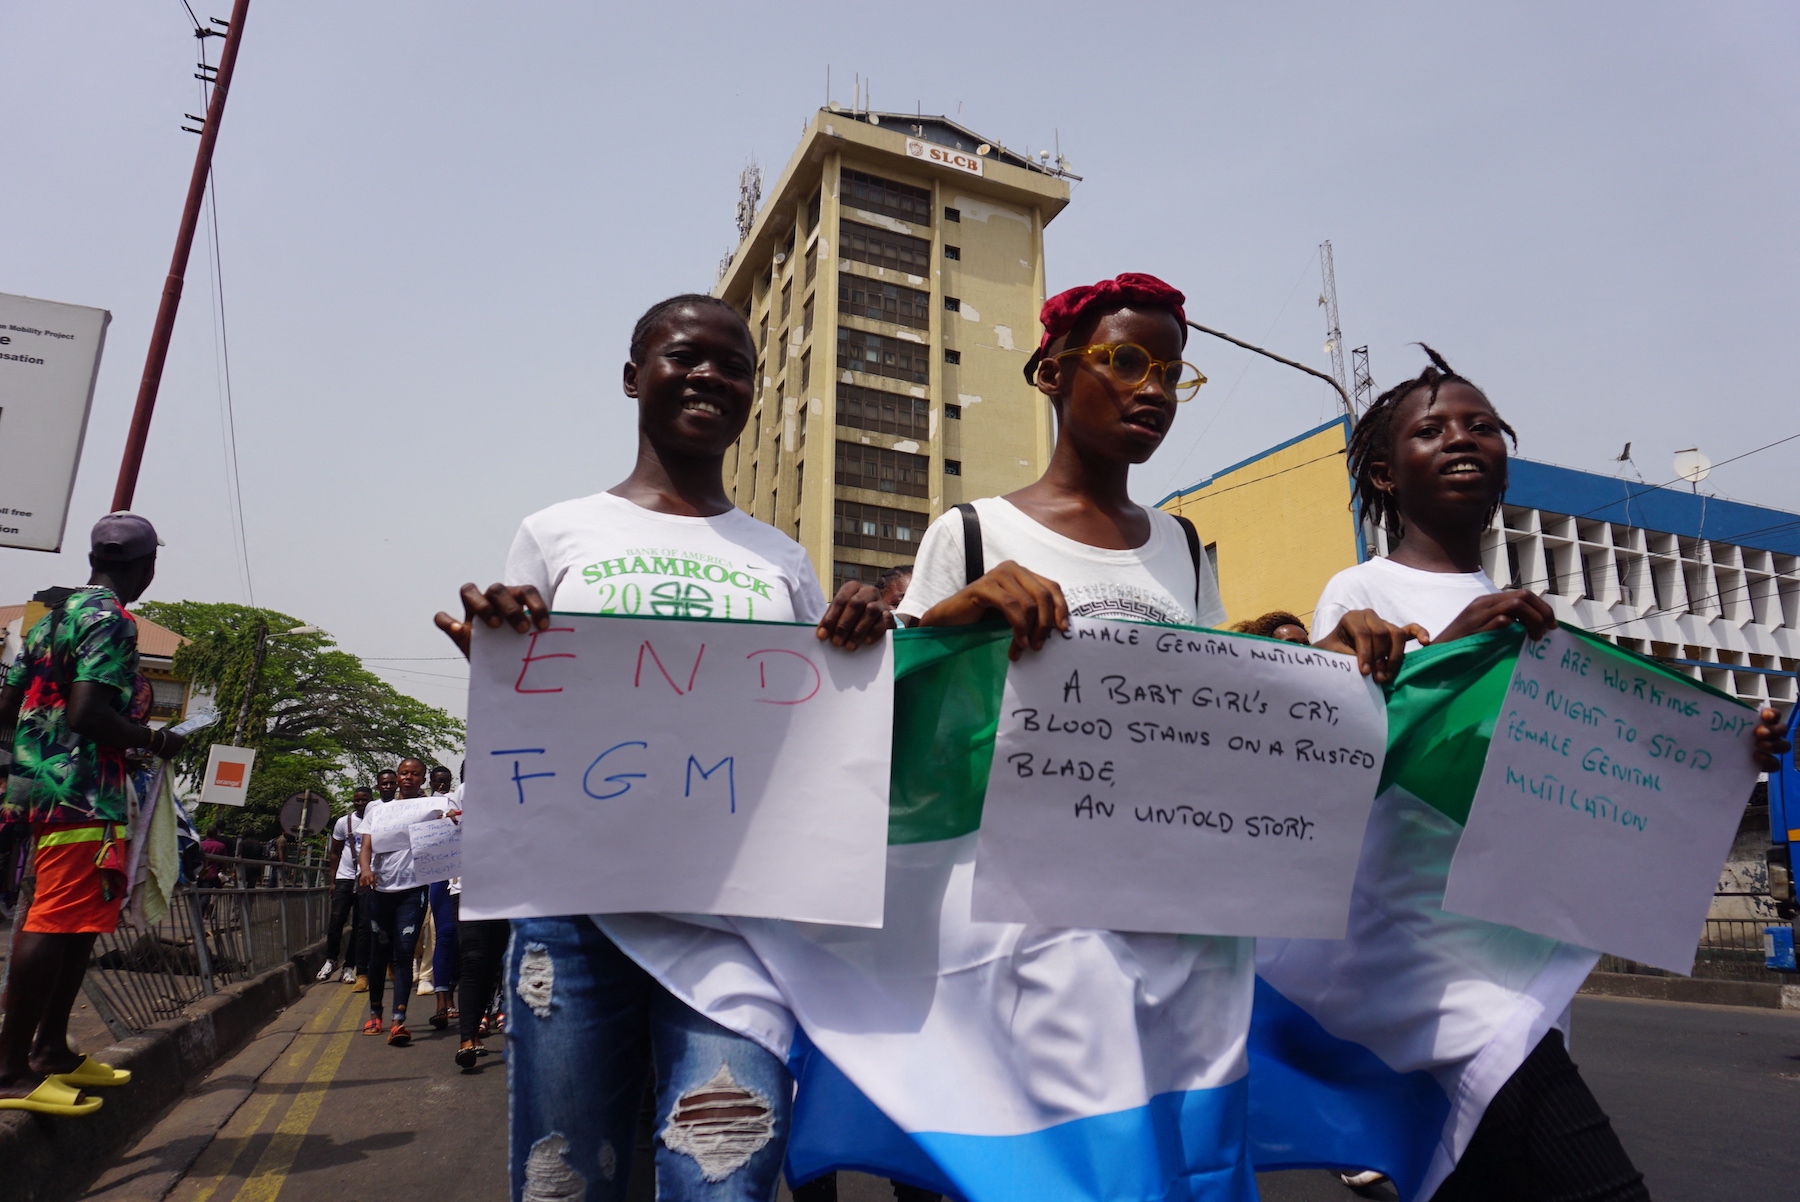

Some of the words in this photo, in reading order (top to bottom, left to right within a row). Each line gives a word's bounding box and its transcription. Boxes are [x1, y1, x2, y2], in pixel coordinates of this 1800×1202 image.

[930, 148, 978, 171] SLCB
[9, 324, 42, 336] Mobility
[44, 330, 74, 340] Project
[11, 508, 33, 517] free
[581, 556, 774, 601] SHAMROCK
[625, 548, 659, 556] BANK
[661, 548, 678, 557] OF
[680, 550, 733, 568] AMERICA
[515, 627, 821, 704] END
[1156, 633, 1239, 658] GENITAL
[1251, 649, 1352, 673] MUTILATION
[1064, 669, 1081, 703] A
[1101, 675, 1182, 705] BABY
[1289, 701, 1339, 726] CRY,
[1560, 648, 1592, 676] ARE
[1604, 668, 1700, 717] WORKING
[1512, 672, 1539, 700] AND
[1546, 690, 1607, 728] NIGHT
[1615, 719, 1637, 743] TO
[1012, 708, 1112, 740] BLOOD
[1128, 722, 1210, 746] STAINS
[1228, 736, 1261, 754] ON
[1269, 740, 1285, 757] A
[1295, 739, 1375, 769] RUSTED
[1508, 710, 1572, 757] FEMALE
[1582, 747, 1662, 792] GENITAL
[215, 779, 240, 787] orange
[490, 741, 735, 813] FGM
[1007, 752, 1116, 788] BLADE,
[1075, 794, 1115, 819] AN
[1134, 804, 1233, 834] UNTOLD
[1245, 815, 1314, 841] STORY.
[1506, 765, 1647, 831] MUTILATION
